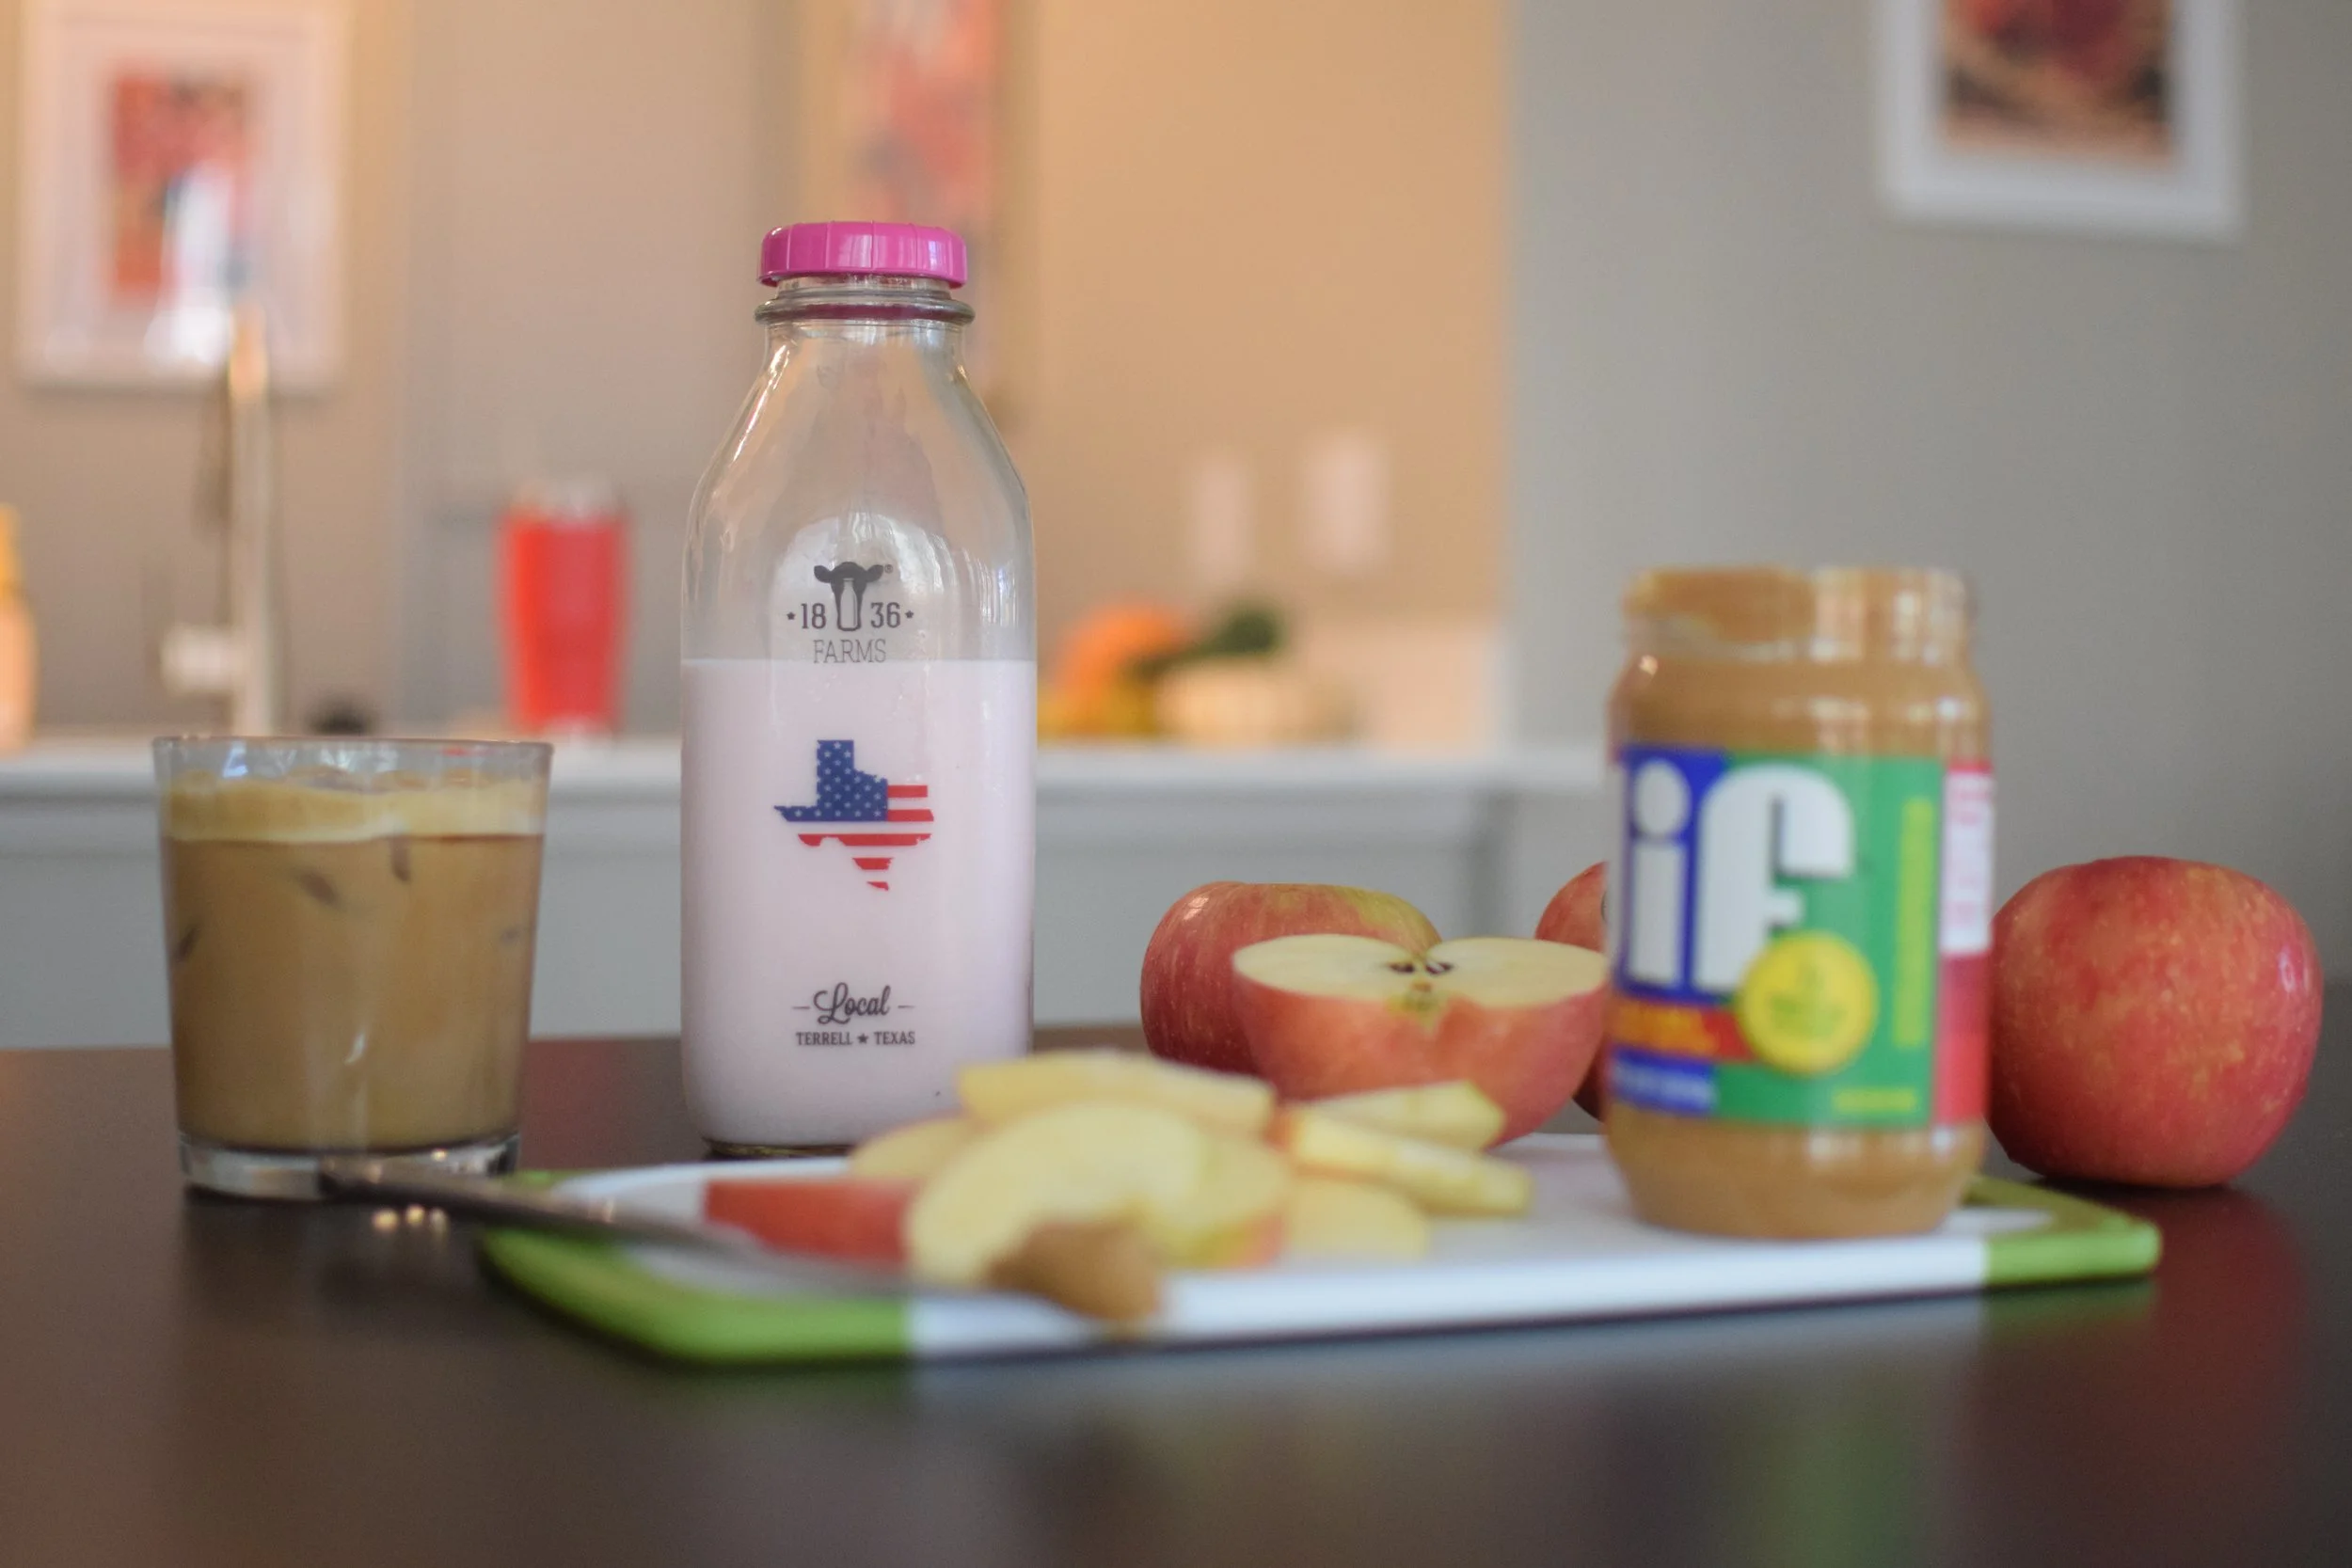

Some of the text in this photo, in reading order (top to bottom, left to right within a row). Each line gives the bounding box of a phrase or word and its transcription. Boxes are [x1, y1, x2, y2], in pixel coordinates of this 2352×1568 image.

[801, 602, 900, 629] 18 36
[813, 639, 886, 663] FARMS
[1610, 759, 1855, 993] if
[813, 982, 891, 1024] Local
[796, 1031, 915, 1046] TERRELL TEXAS
